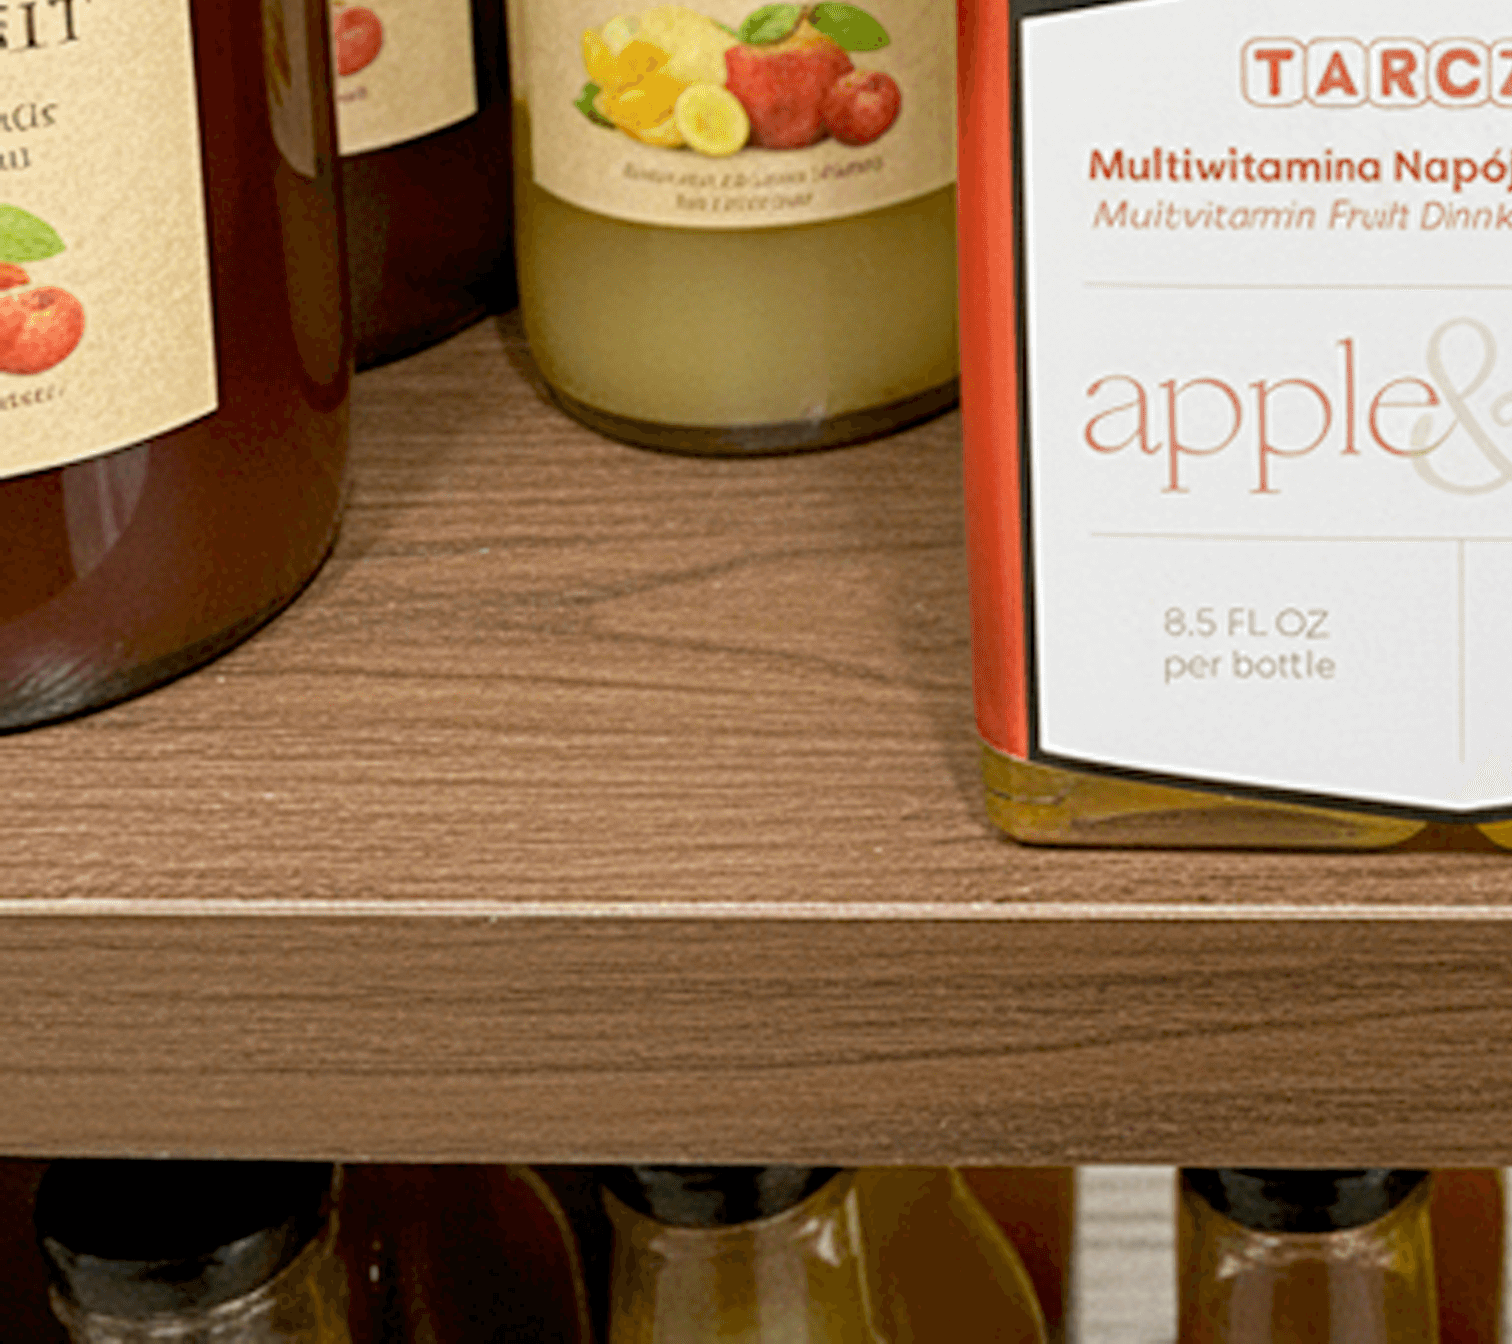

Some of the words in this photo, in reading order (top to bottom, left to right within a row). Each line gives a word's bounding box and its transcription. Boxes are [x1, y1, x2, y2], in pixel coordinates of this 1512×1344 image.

[1089, 146, 1383, 183] Multiwitamina
[1164, 606, 1218, 638] 8.5
[1227, 606, 1268, 637] FL
[1274, 607, 1331, 640] OZ
[1164, 654, 1222, 685] per
[1231, 649, 1337, 680] bottle
